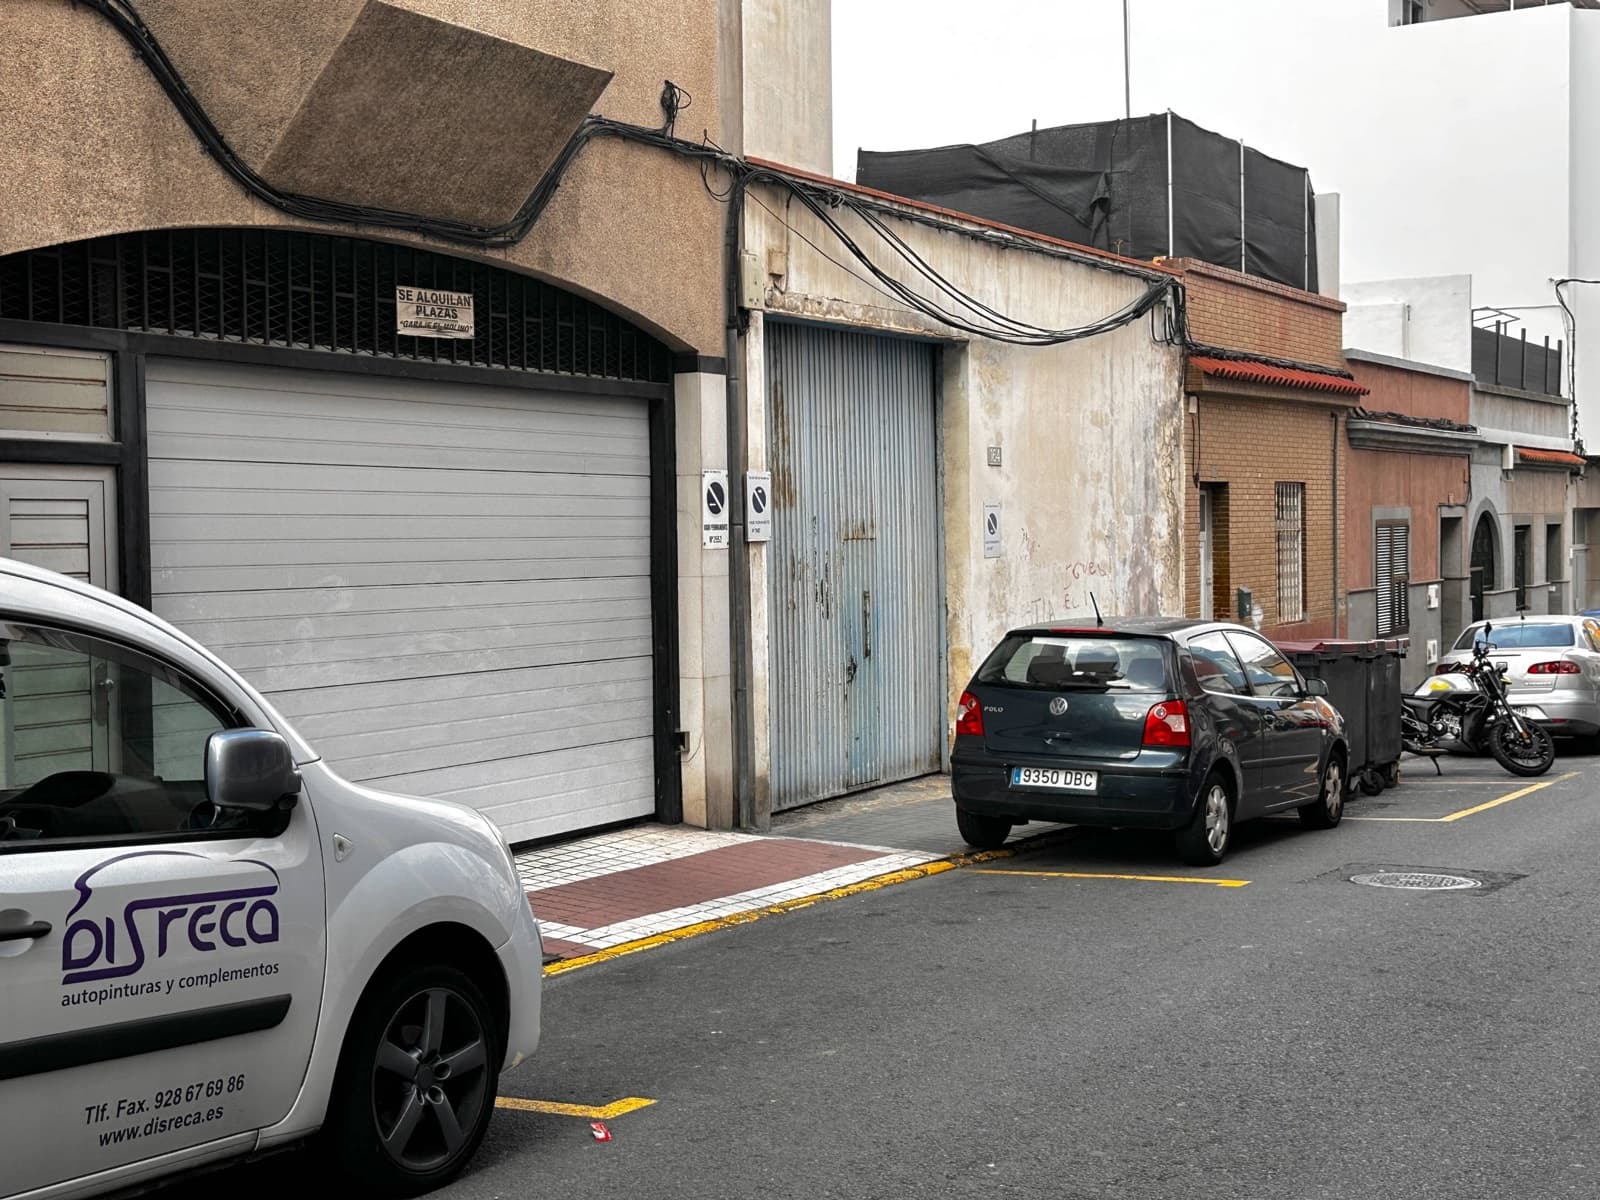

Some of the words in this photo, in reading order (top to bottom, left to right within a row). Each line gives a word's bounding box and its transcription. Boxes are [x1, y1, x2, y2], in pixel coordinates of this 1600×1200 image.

[399, 289, 413, 301] SE
[416, 291, 471, 306] ALQUILAN
[415, 305, 458, 319] PLAZAS
[1023, 768, 1060, 785] 9350
[1063, 771, 1093, 787] DBC
[61, 979, 161, 1006] autopinturas
[166, 979, 175, 994] y
[178, 962, 280, 990] complementos
[85, 1105, 110, 1125] Tlf.
[116, 1098, 150, 1120] Fax.
[154, 1087, 182, 1109] 928
[185, 1082, 204, 1103] 67
[205, 1078, 224, 1098] 69
[227, 1073, 246, 1094] 86
[98, 1104, 224, 1148] www.disreca.es
